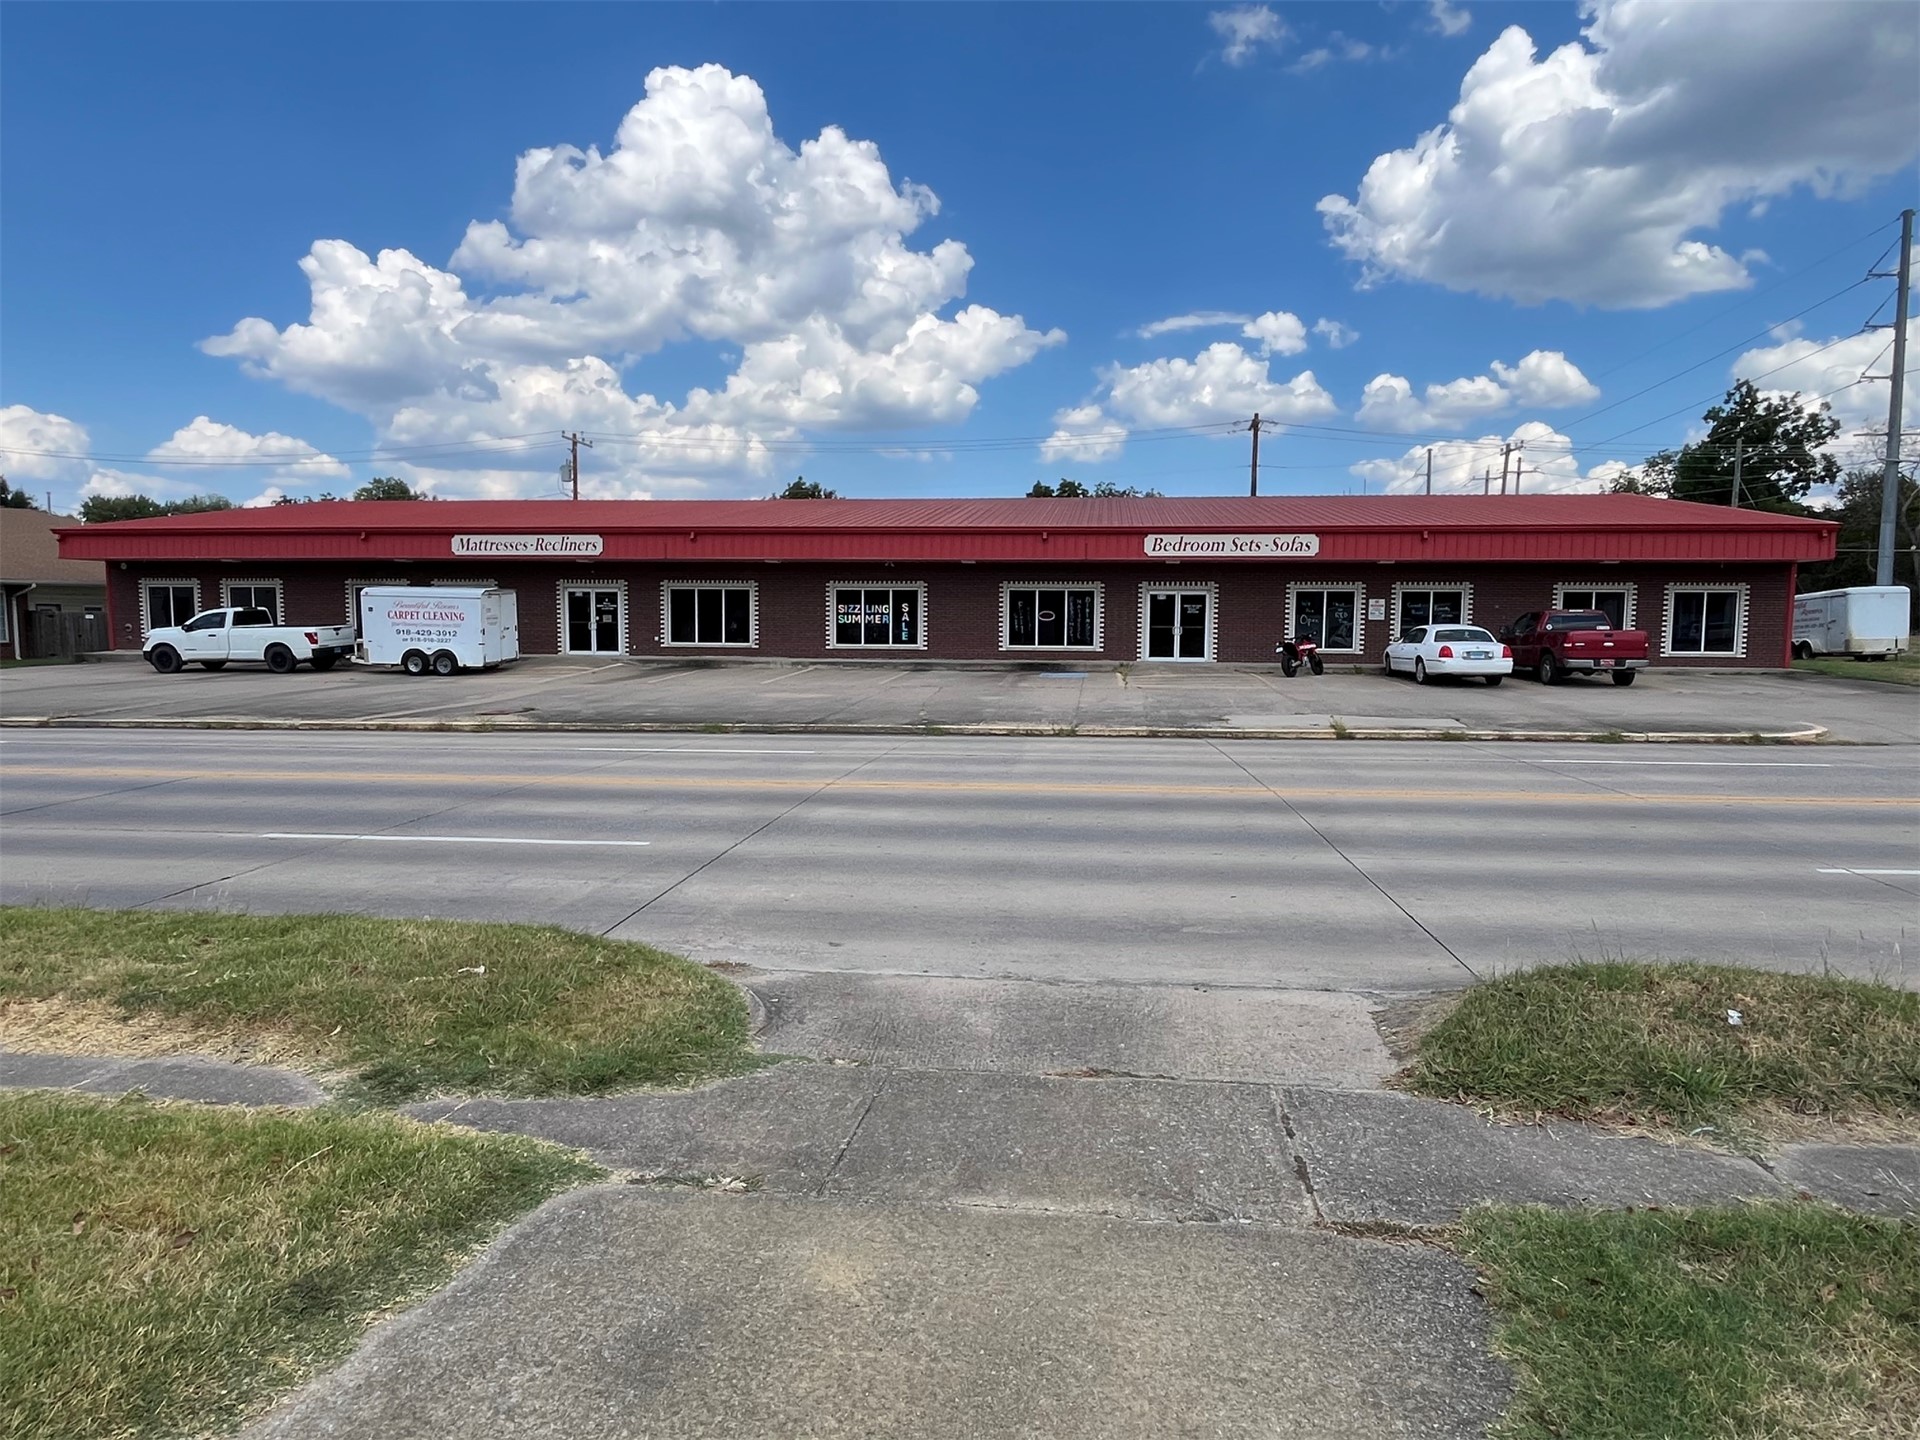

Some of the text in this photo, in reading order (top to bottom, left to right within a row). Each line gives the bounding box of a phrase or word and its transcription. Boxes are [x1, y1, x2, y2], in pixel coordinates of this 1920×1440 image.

[457, 536, 598, 551] Mattresses Recliners
[1152, 535, 1312, 552] Bedroom Sets Sofas
[387, 610, 465, 621] CARPET CLEANING
[901, 603, 909, 640] SALE
[395, 628, 458, 637] 918-429-3912
